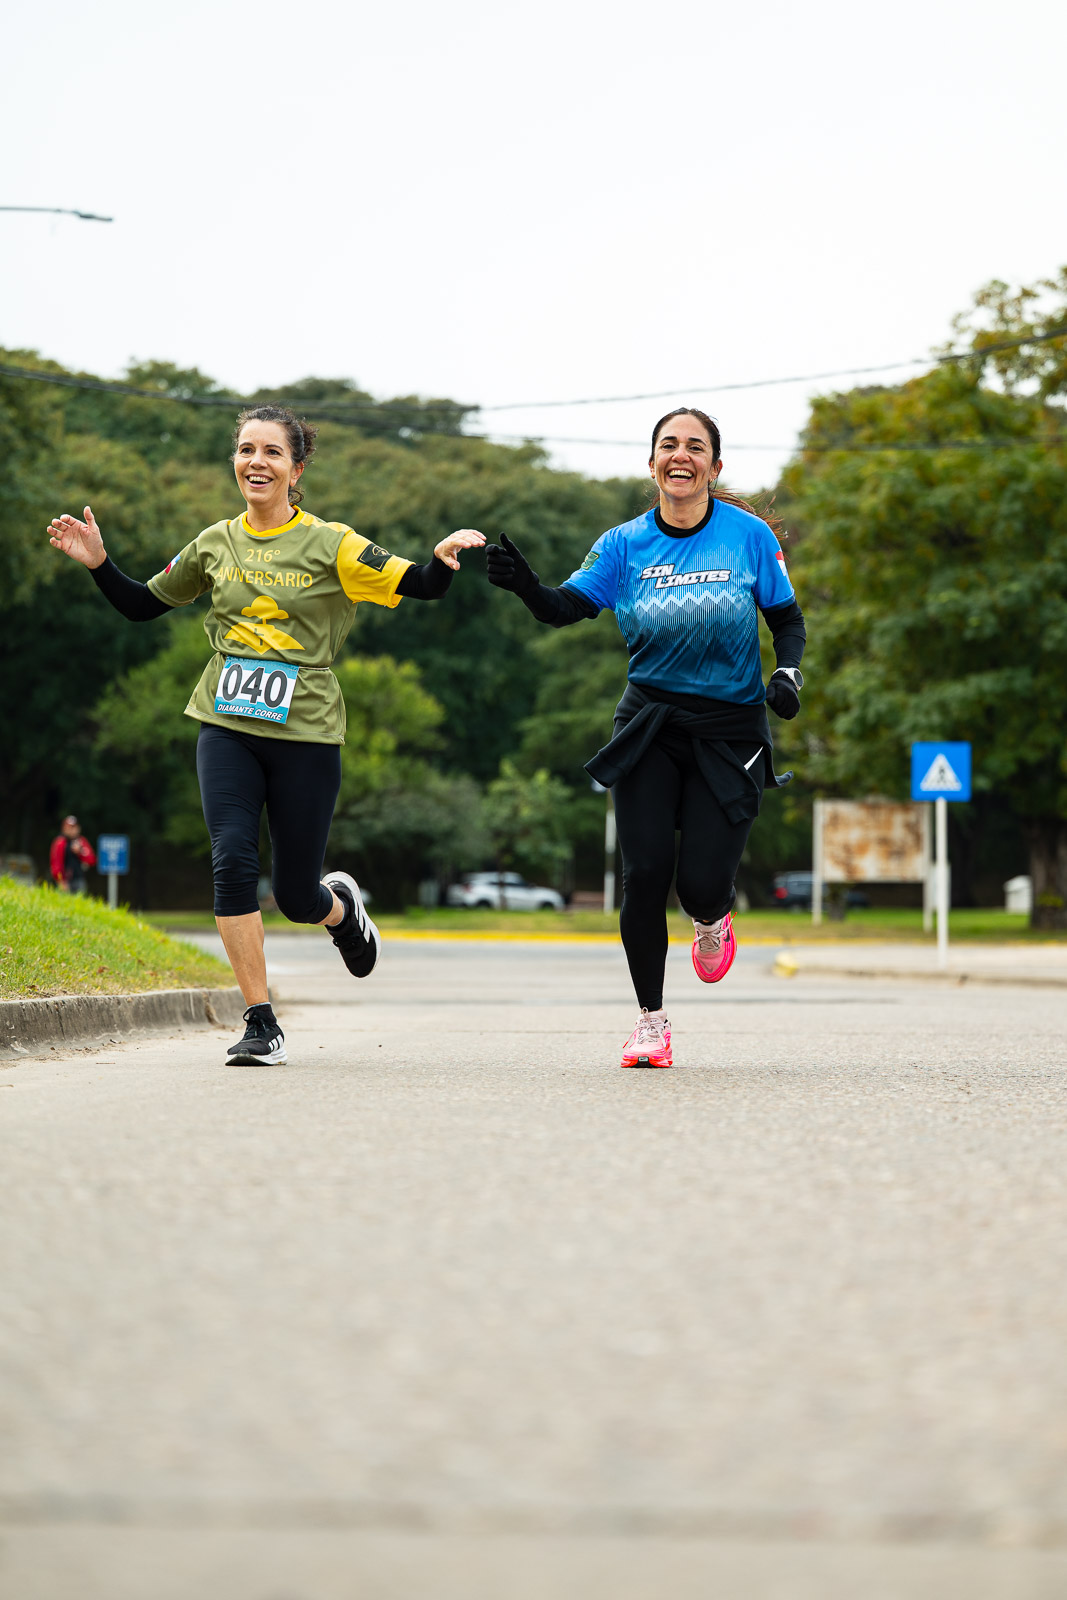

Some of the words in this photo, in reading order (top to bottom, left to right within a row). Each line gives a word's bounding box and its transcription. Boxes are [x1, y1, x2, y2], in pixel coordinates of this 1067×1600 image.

[214, 566, 313, 588] ANIVERSARIO
[640, 564, 675, 580] SIN
[654, 569, 732, 589] LIMITES
[222, 663, 288, 708] 040
[217, 704, 254, 714] DIAMANTE
[254, 708, 284, 720] CORRE
